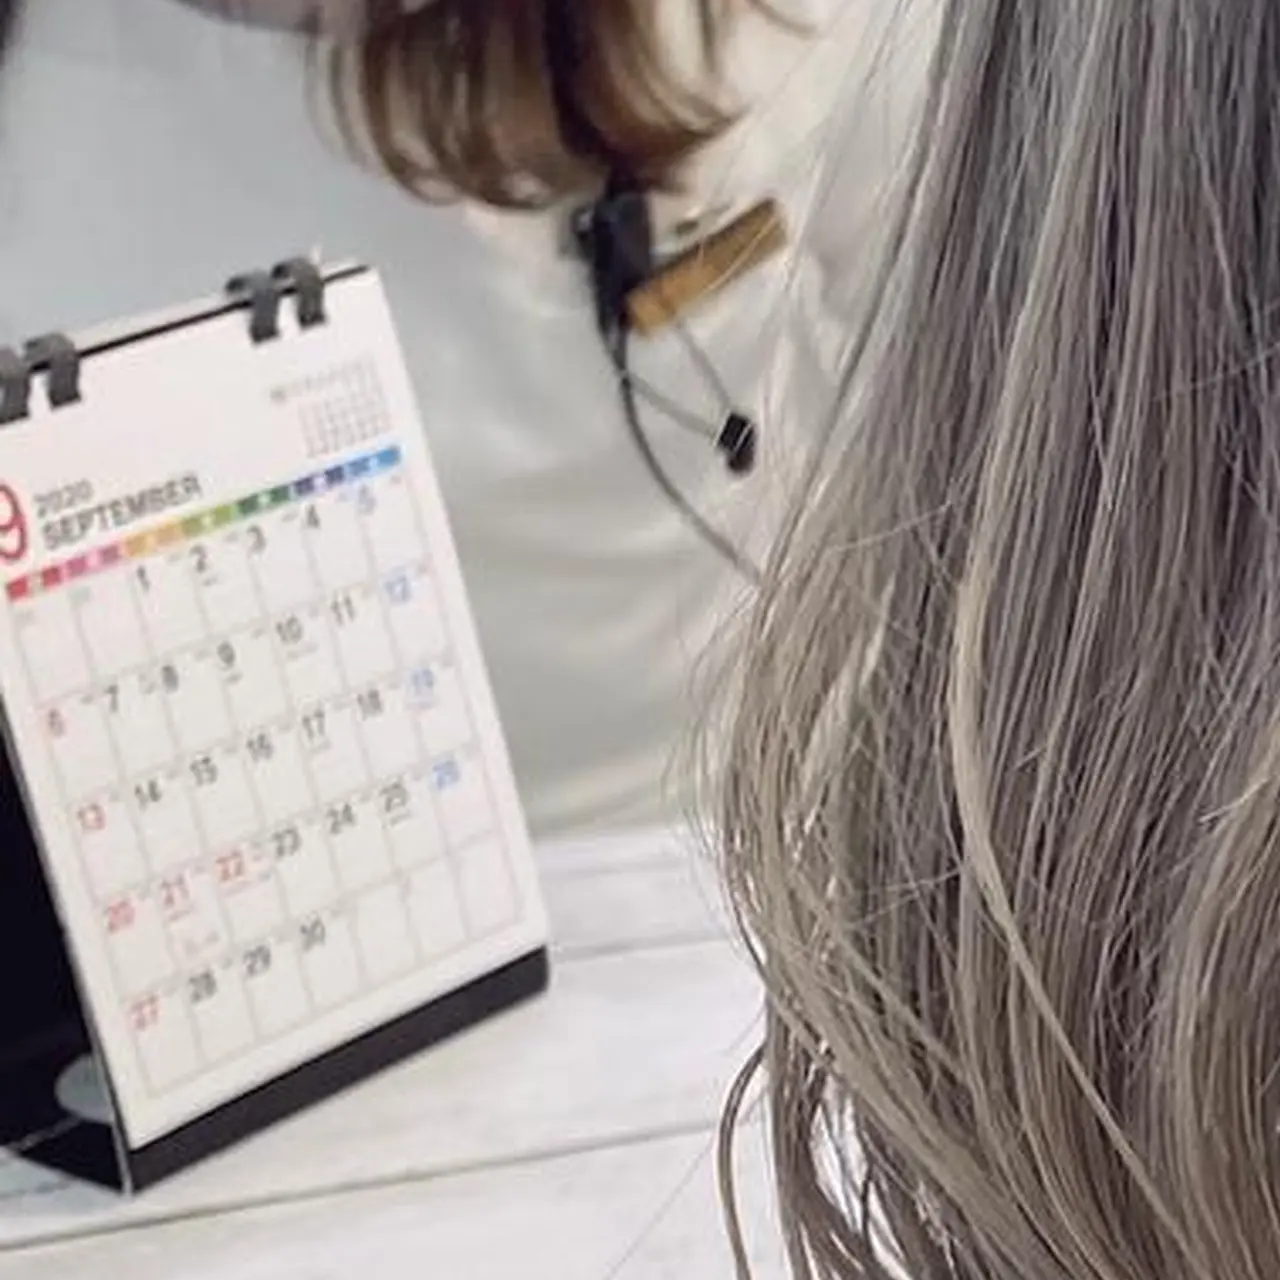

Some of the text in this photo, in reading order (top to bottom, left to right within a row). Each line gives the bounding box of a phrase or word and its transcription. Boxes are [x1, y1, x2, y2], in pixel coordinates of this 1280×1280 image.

[33, 480, 94, 517] 2020
[40, 475, 202, 550] SEPTEMBER
[136, 486, 377, 591] 1 2 3 4 5
[106, 686, 120, 713] 7
[162, 665, 179, 692] 8
[217, 643, 236, 668] 9
[276, 617, 303, 645] 10
[330, 595, 354, 623] 11
[134, 781, 162, 808] 14
[189, 757, 217, 785] 15
[246, 733, 273, 763] 16
[303, 711, 327, 739] 17
[357, 689, 383, 717] 18
[161, 877, 188, 908] 21
[215, 851, 245, 883] 22
[272, 827, 300, 858] 23
[326, 803, 355, 834] 24
[380, 782, 409, 810] 25
[187, 971, 217, 1002] 28
[242, 946, 272, 976] 29
[300, 919, 326, 951] 30
